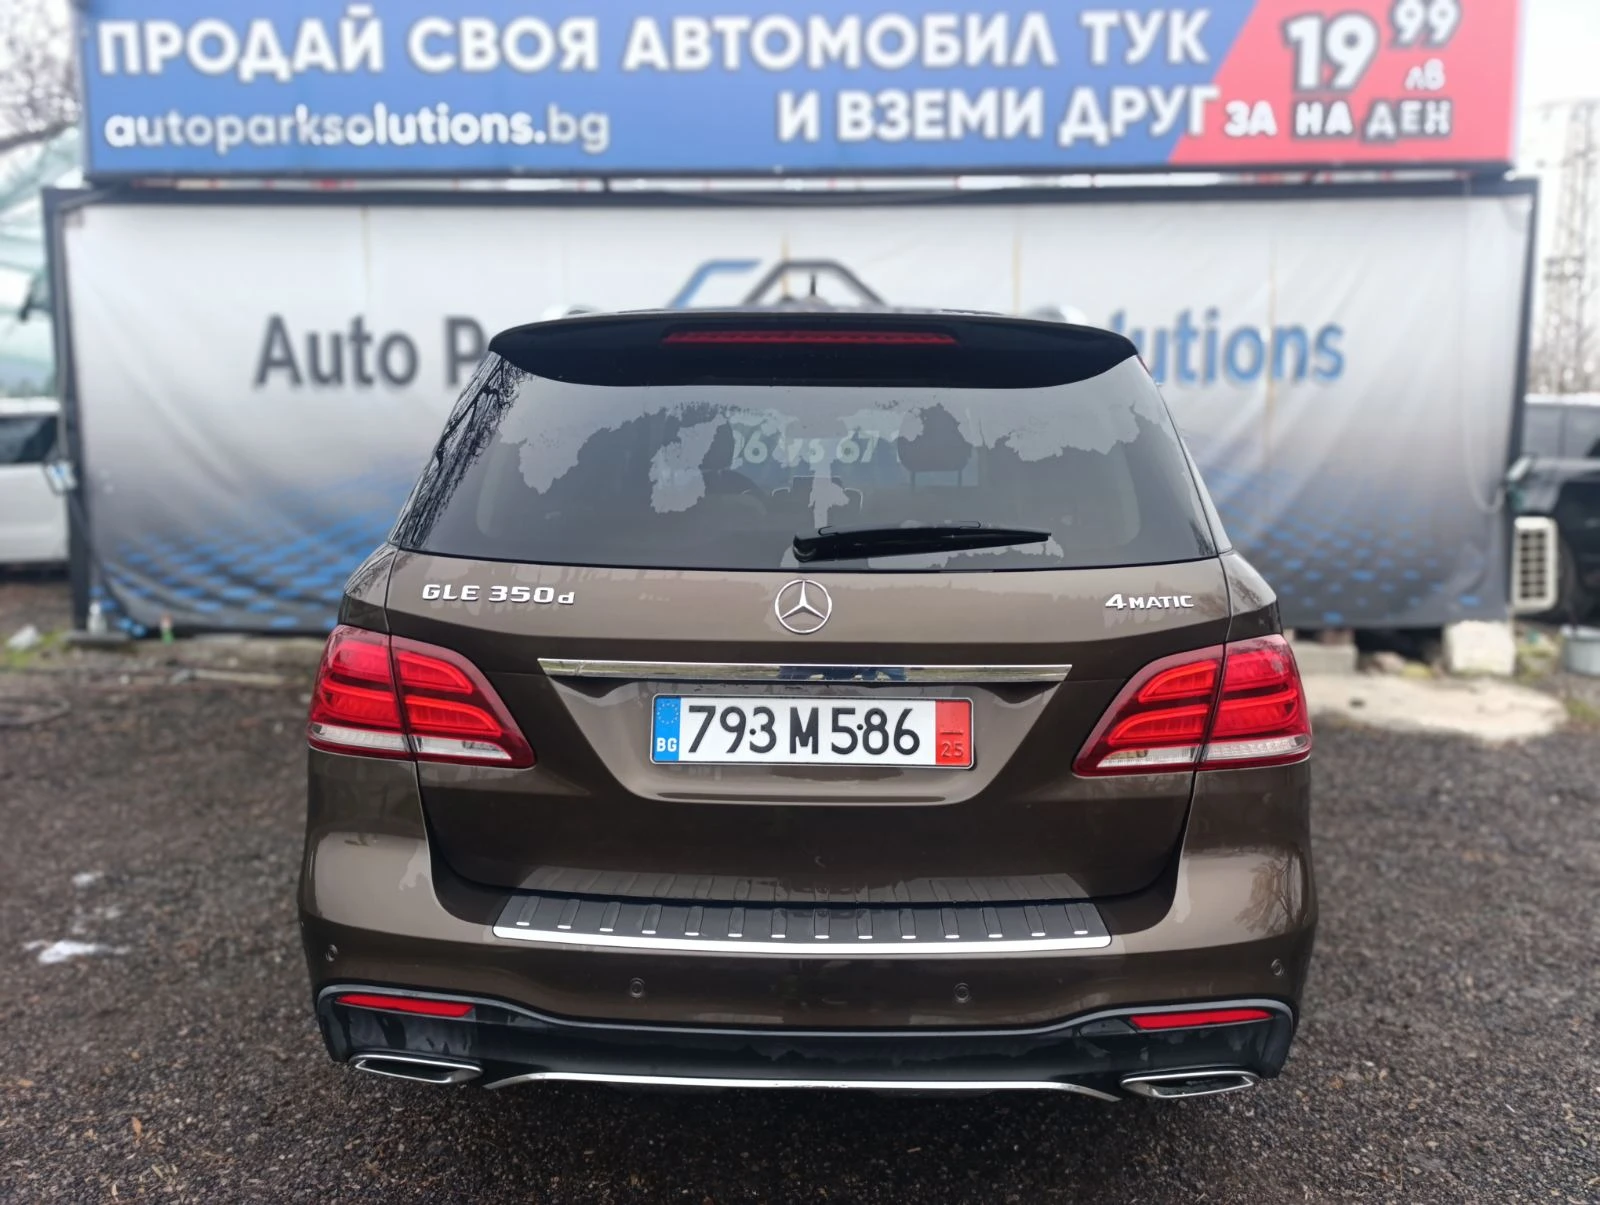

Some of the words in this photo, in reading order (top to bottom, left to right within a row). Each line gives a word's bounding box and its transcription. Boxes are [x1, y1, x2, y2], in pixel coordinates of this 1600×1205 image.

[99, 4, 384, 82] ПРОДАЙ
[407, 17, 598, 73] СВОЯ
[622, 11, 1058, 71] АВТОМОБИЛ
[1080, 9, 1210, 66] ТУК
[1285, 13, 1377, 90] 19
[1391, 0, 1460, 44] 99
[104, 103, 609, 154] autoparksolutions.bg
[777, 90, 820, 142] И
[836, 88, 1044, 141] ВЗЕМИ
[1057, 84, 1221, 148] ДРУГ
[1224, 99, 1278, 138] ЗА
[1294, 100, 1354, 137] НА
[1364, 100, 1451, 140] ДЕН
[254, 313, 420, 387] Auto
[421, 583, 481, 602] GLE
[488, 585, 575, 605] 350d
[1104, 593, 1195, 610] 4MATIC
[656, 736, 677, 752] BG
[687, 704, 778, 754] 793
[788, 706, 819, 755] M
[830, 707, 921, 756] 586
[941, 741, 965, 758] 25
